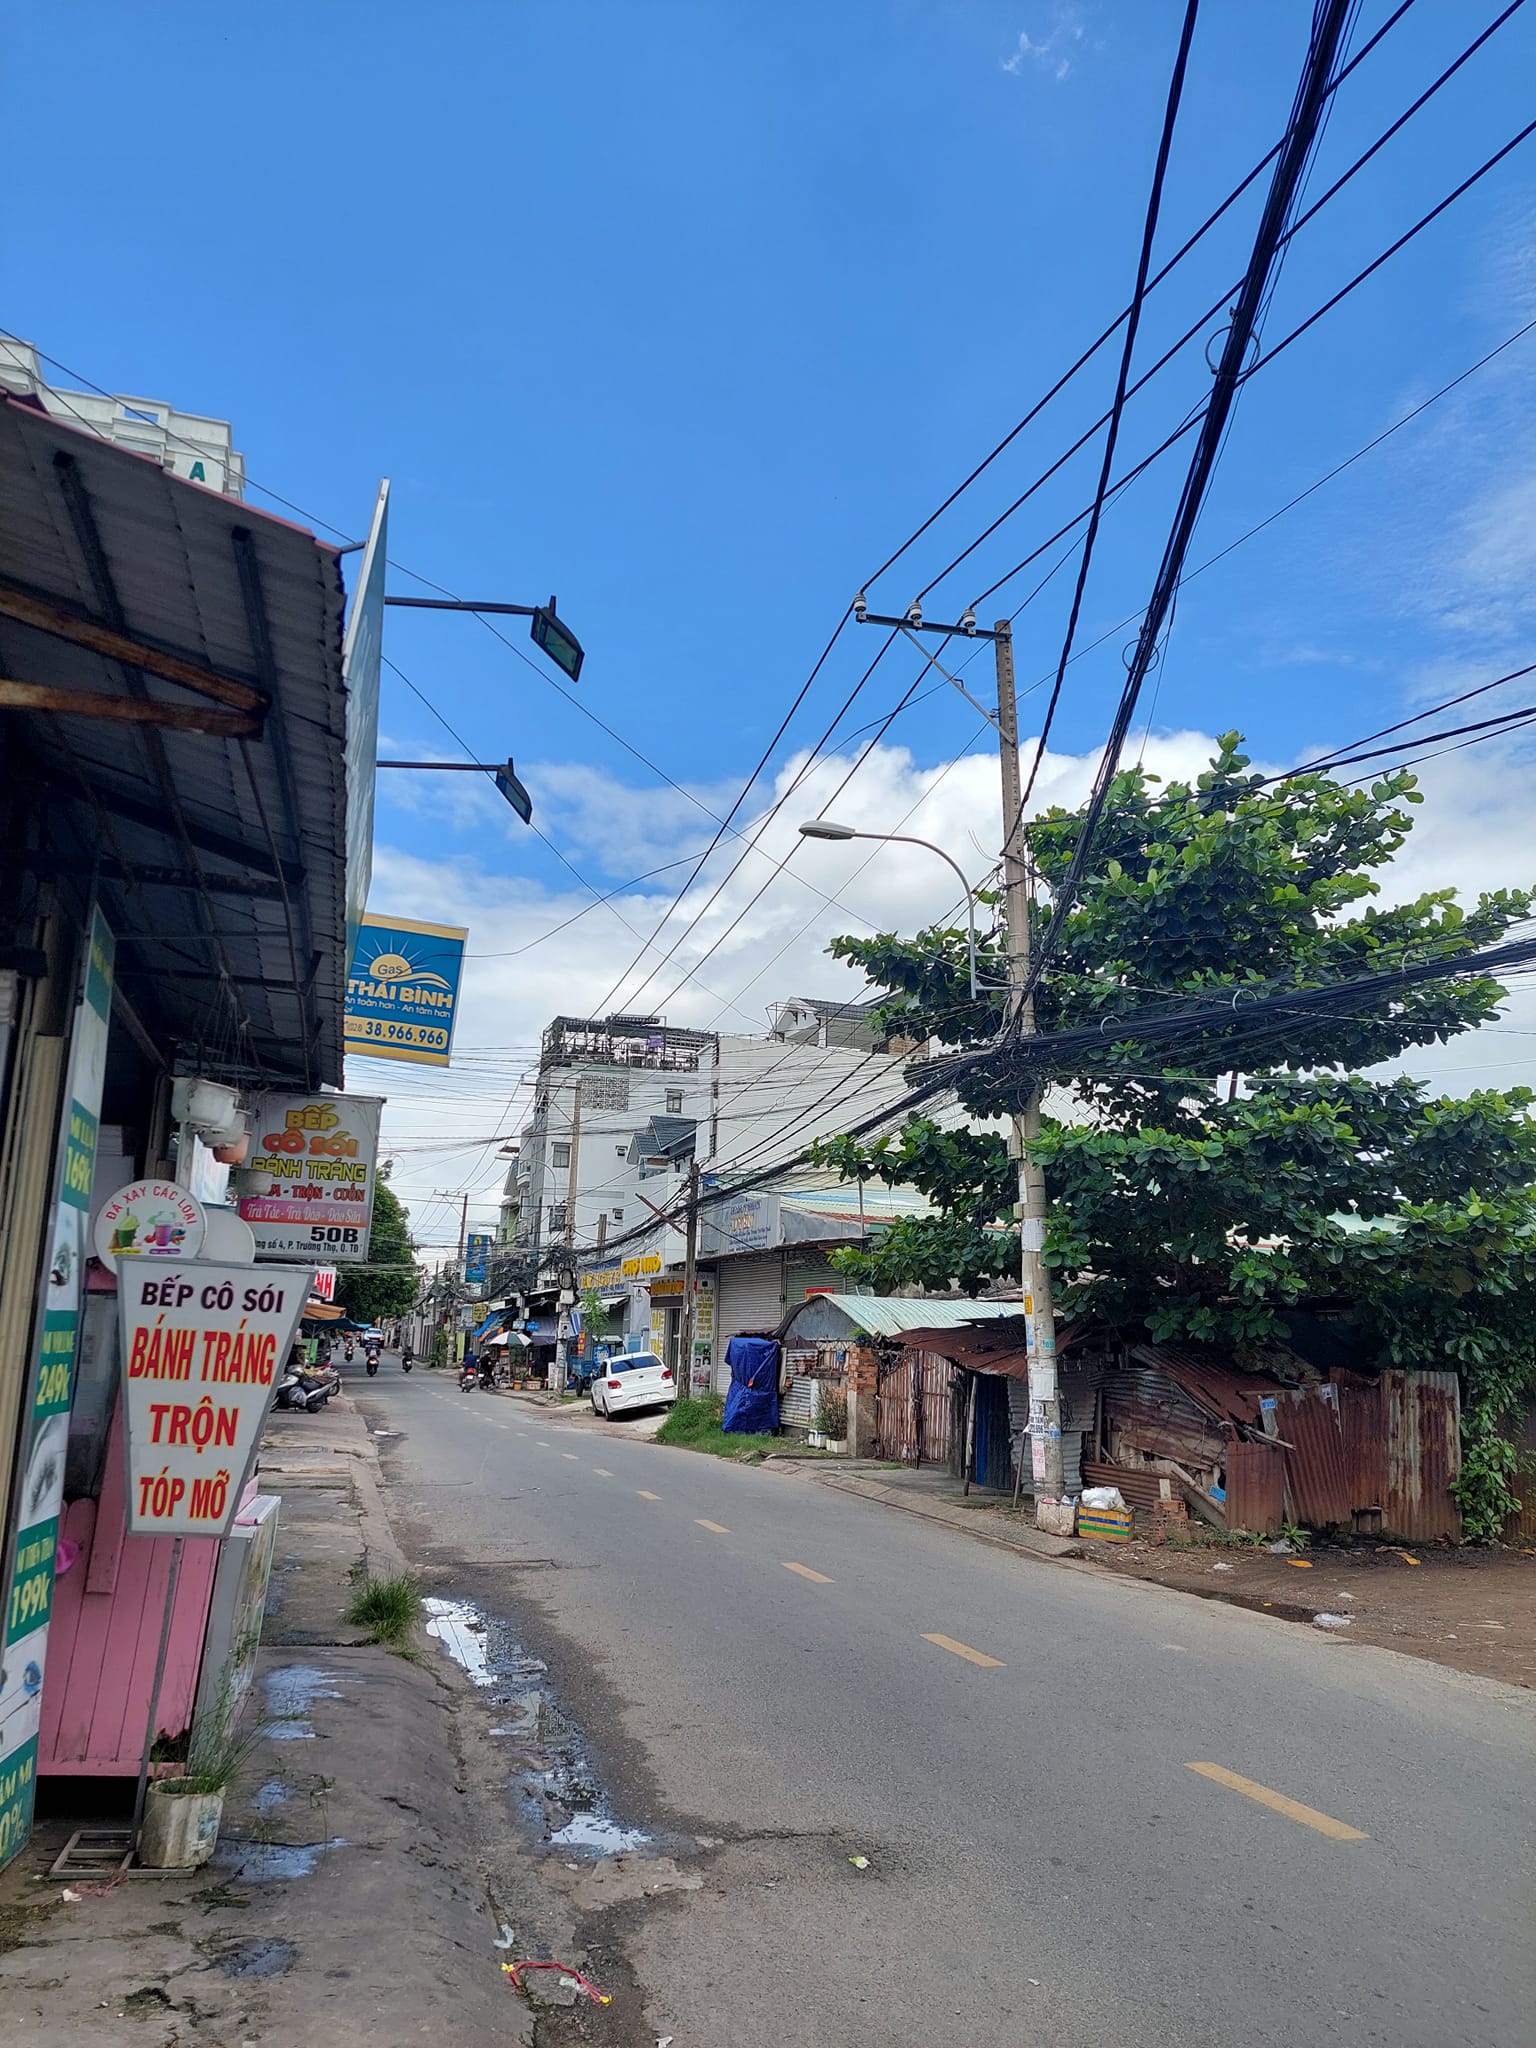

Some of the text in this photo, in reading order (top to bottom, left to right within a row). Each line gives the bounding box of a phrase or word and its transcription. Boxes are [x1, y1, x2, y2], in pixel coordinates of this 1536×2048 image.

[189, 461, 205, 482] A
[377, 964, 403, 975] Gas
[399, 985, 453, 1009] BÌNH
[402, 1004, 414, 1014] An
[365, 1021, 444, 1046] 38.966.966
[285, 1103, 340, 1131] BẾP
[262, 1127, 359, 1158] CÔ SÓI
[306, 1158, 367, 1183] TRÁNG
[122, 1186, 147, 1204] XAY
[152, 1184, 178, 1201] CÁC
[291, 1183, 323, 1201] TRỘN
[310, 1226, 359, 1243] 50B
[140, 1275, 284, 1314] BẾP CÔ SÓI
[127, 1313, 277, 1386] BÁNH TRÁNG
[149, 1395, 239, 1455] TRỘN
[139, 1466, 231, 1520] TÓP MỠ
